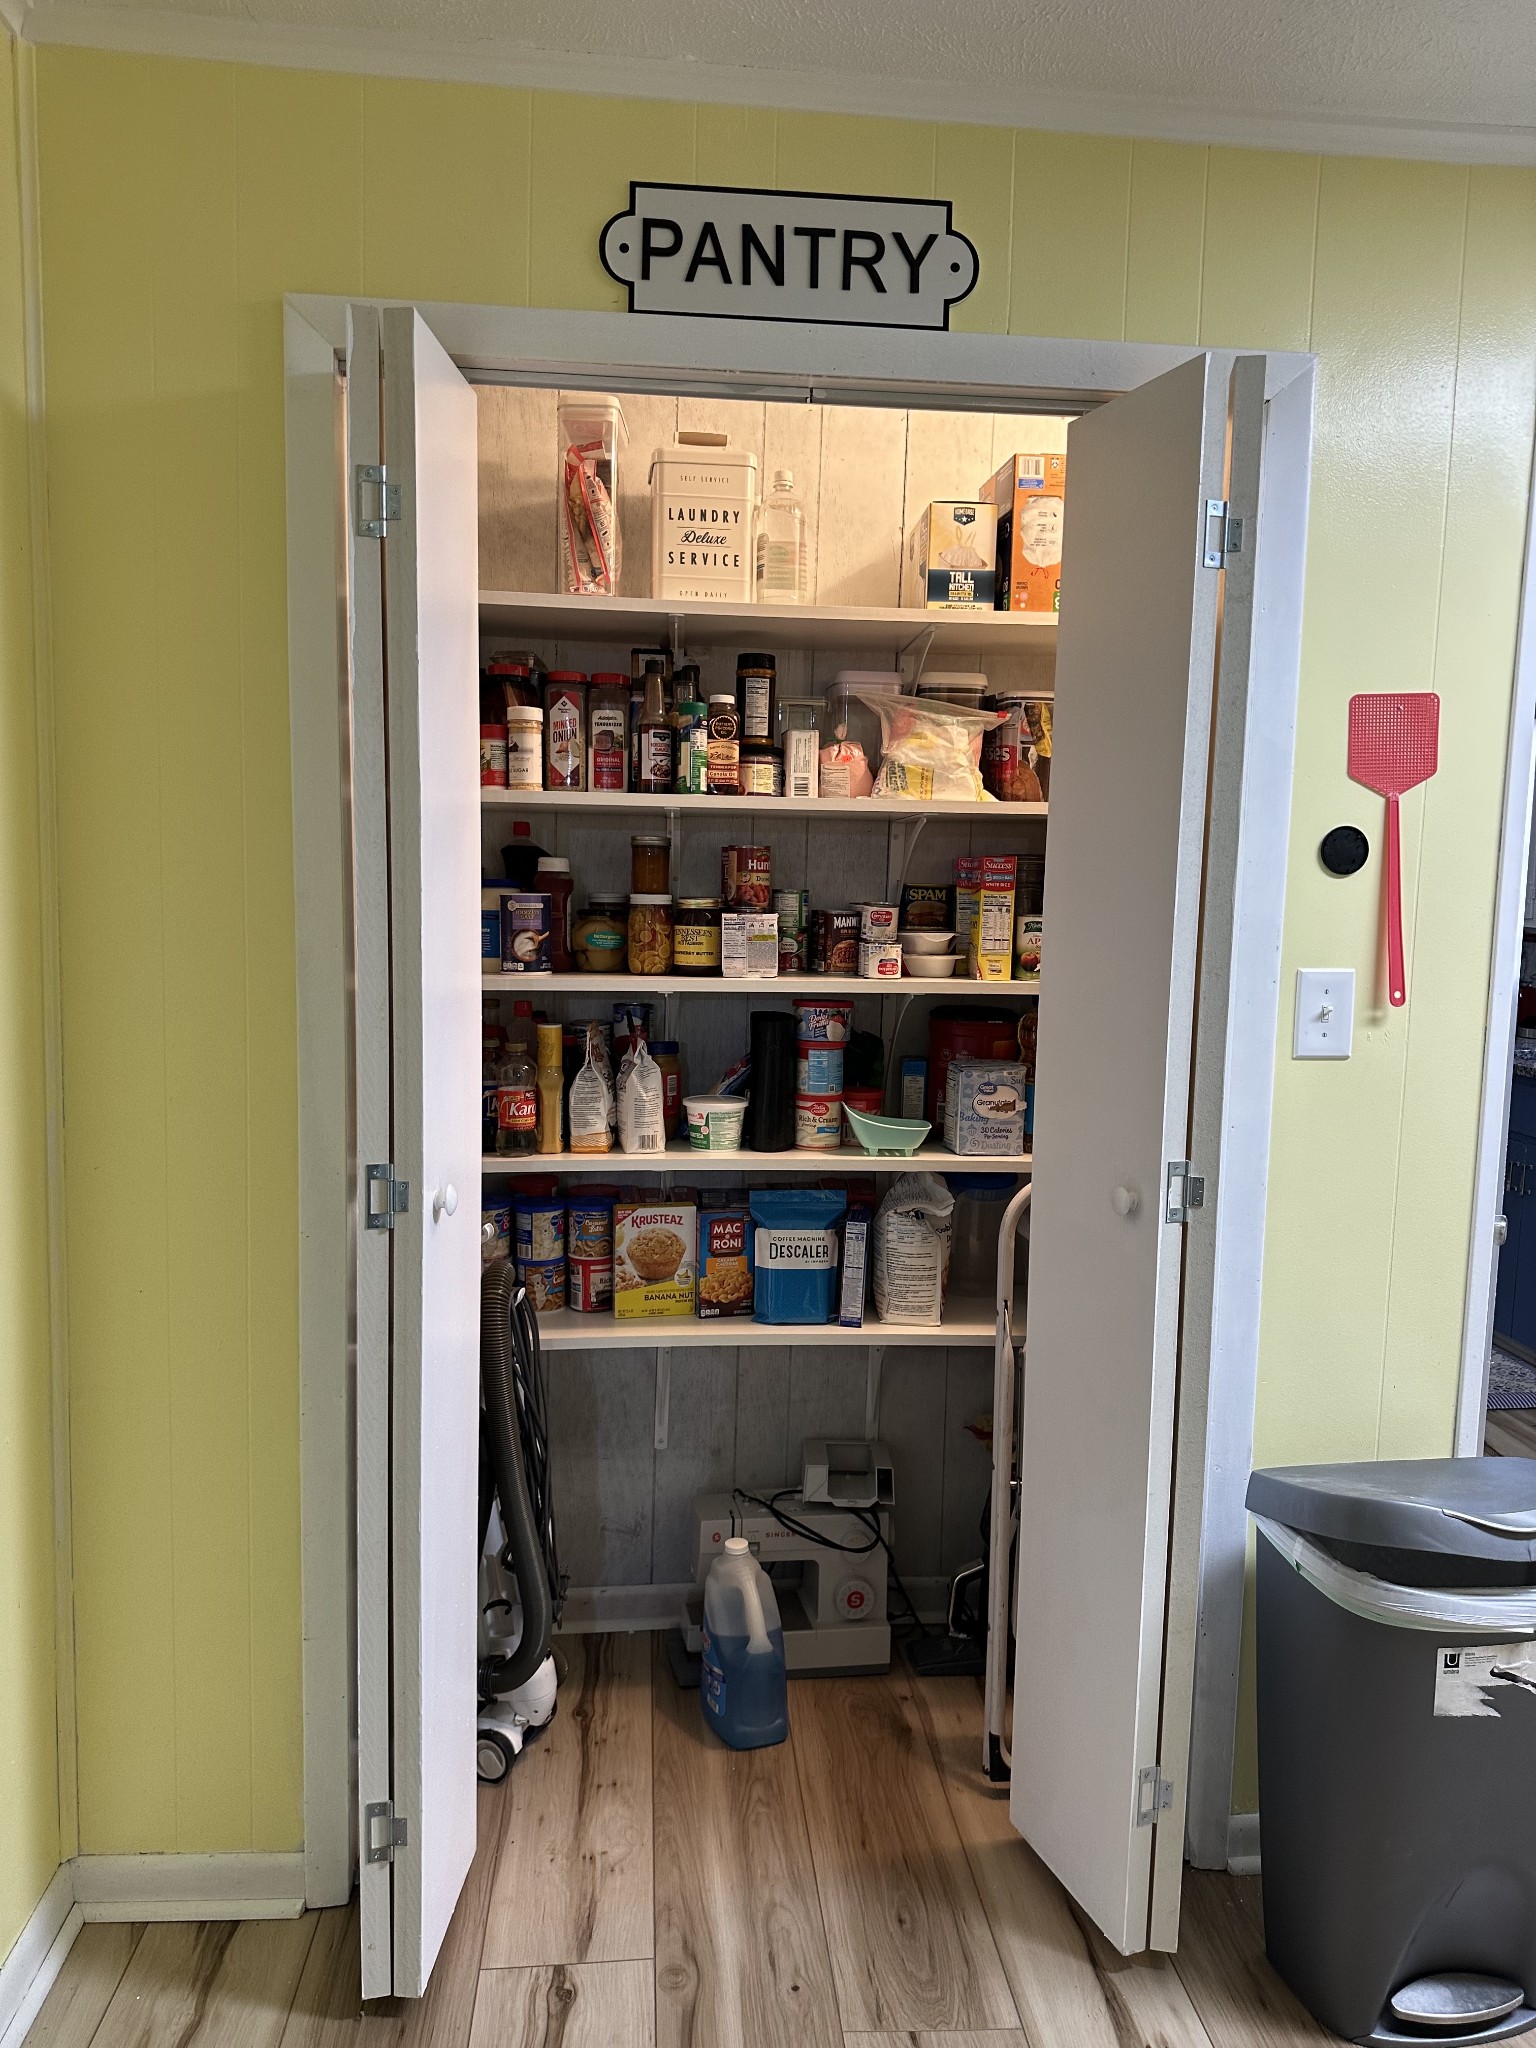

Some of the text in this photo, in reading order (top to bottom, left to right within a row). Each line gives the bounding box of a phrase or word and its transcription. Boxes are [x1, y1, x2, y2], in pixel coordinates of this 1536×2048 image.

[641, 217, 939, 293] PANTRY
[700, 476, 729, 484] SERVICE
[668, 507, 740, 524] LAUNDRY
[681, 530, 727, 545] Deluxe
[668, 551, 740, 567] SERVICE
[950, 571, 974, 583] TALL
[748, 859, 770, 870] Hun
[986, 860, 1012, 869] Success
[909, 888, 946, 901] SPAM
[960, 1111, 989, 1124] Baking
[981, 1140, 1012, 1149] Dusting
[632, 1214, 683, 1228] KRUSTEAZ
[713, 1223, 741, 1234] MAC
[713, 1238, 741, 1249] RONI
[770, 1243, 829, 1260] DESCALER
[644, 1293, 677, 1301] BANANA
[678, 1291, 694, 1299] NUT
